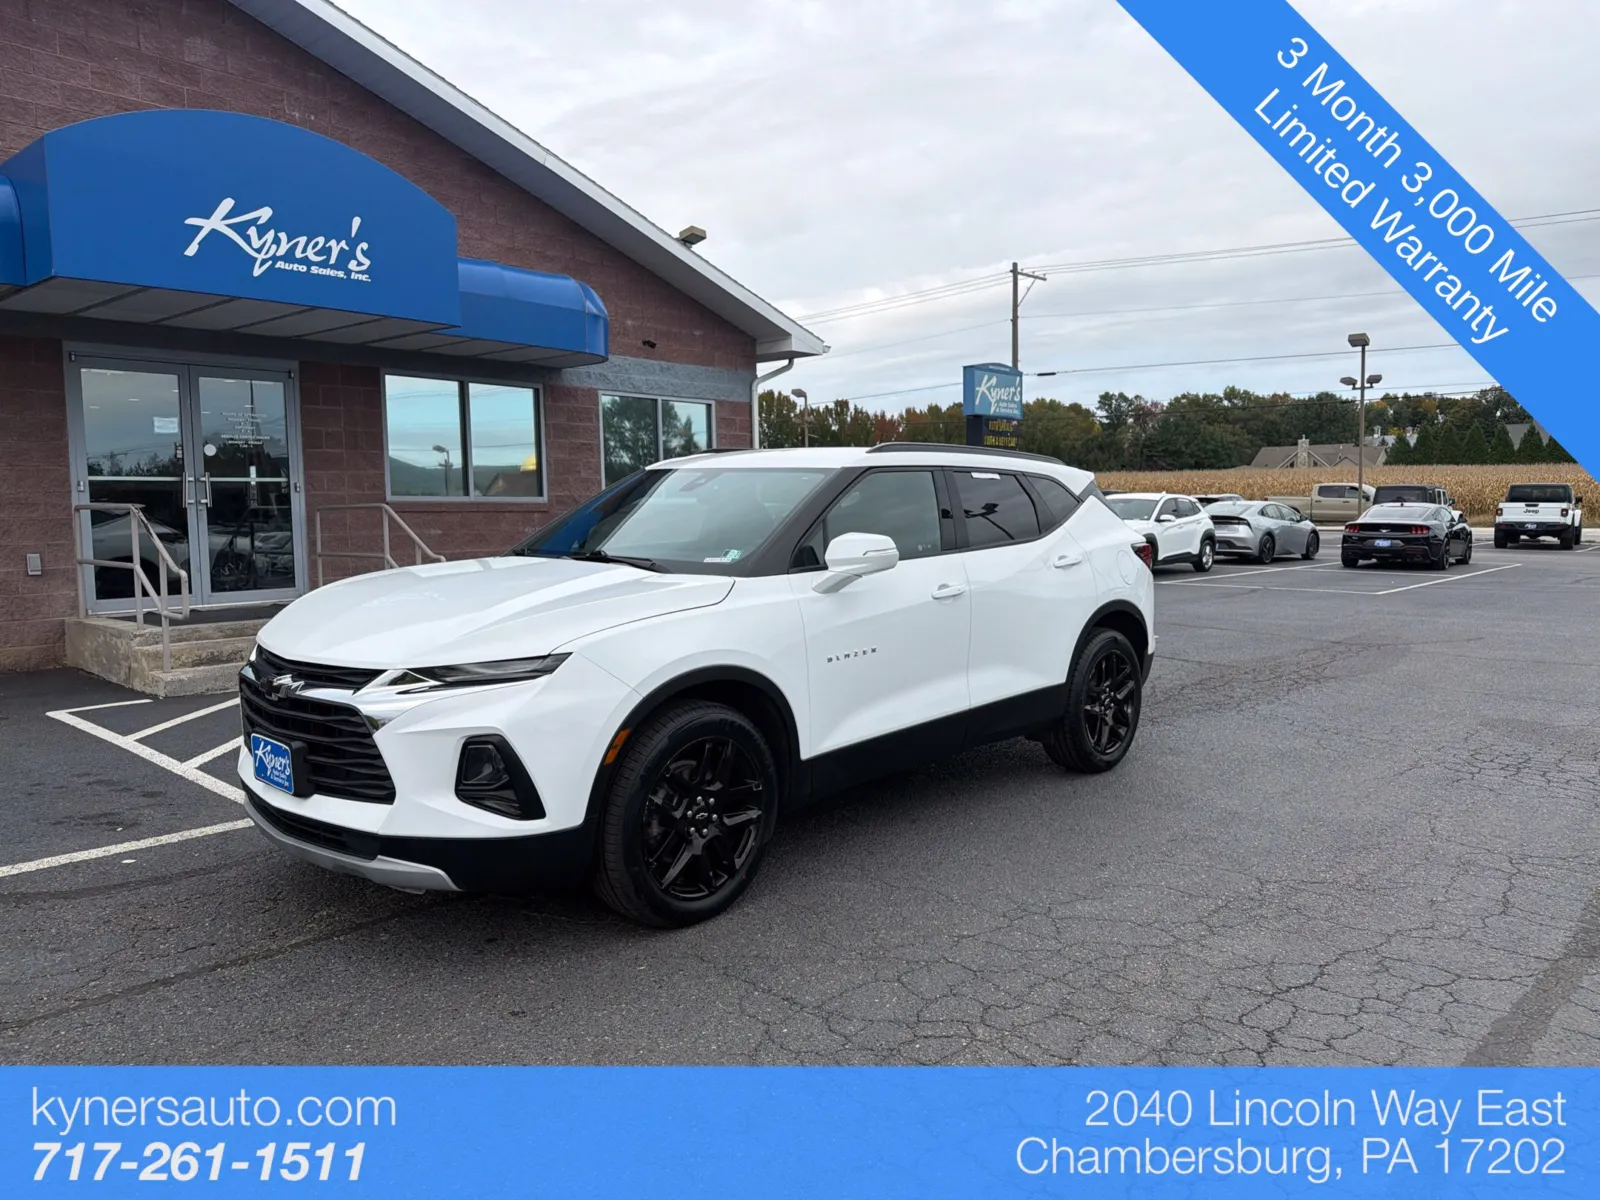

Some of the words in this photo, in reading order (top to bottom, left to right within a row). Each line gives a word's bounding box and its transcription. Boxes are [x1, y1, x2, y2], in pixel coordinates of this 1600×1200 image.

[183, 196, 372, 278] Kyner's
[274, 260, 308, 273] Auto
[310, 265, 348, 280] Sales,
[350, 271, 372, 283] Inc.
[975, 374, 1021, 414] Kyner's
[827, 646, 877, 663] BLAZER
[255, 741, 290, 776] Kyner's
